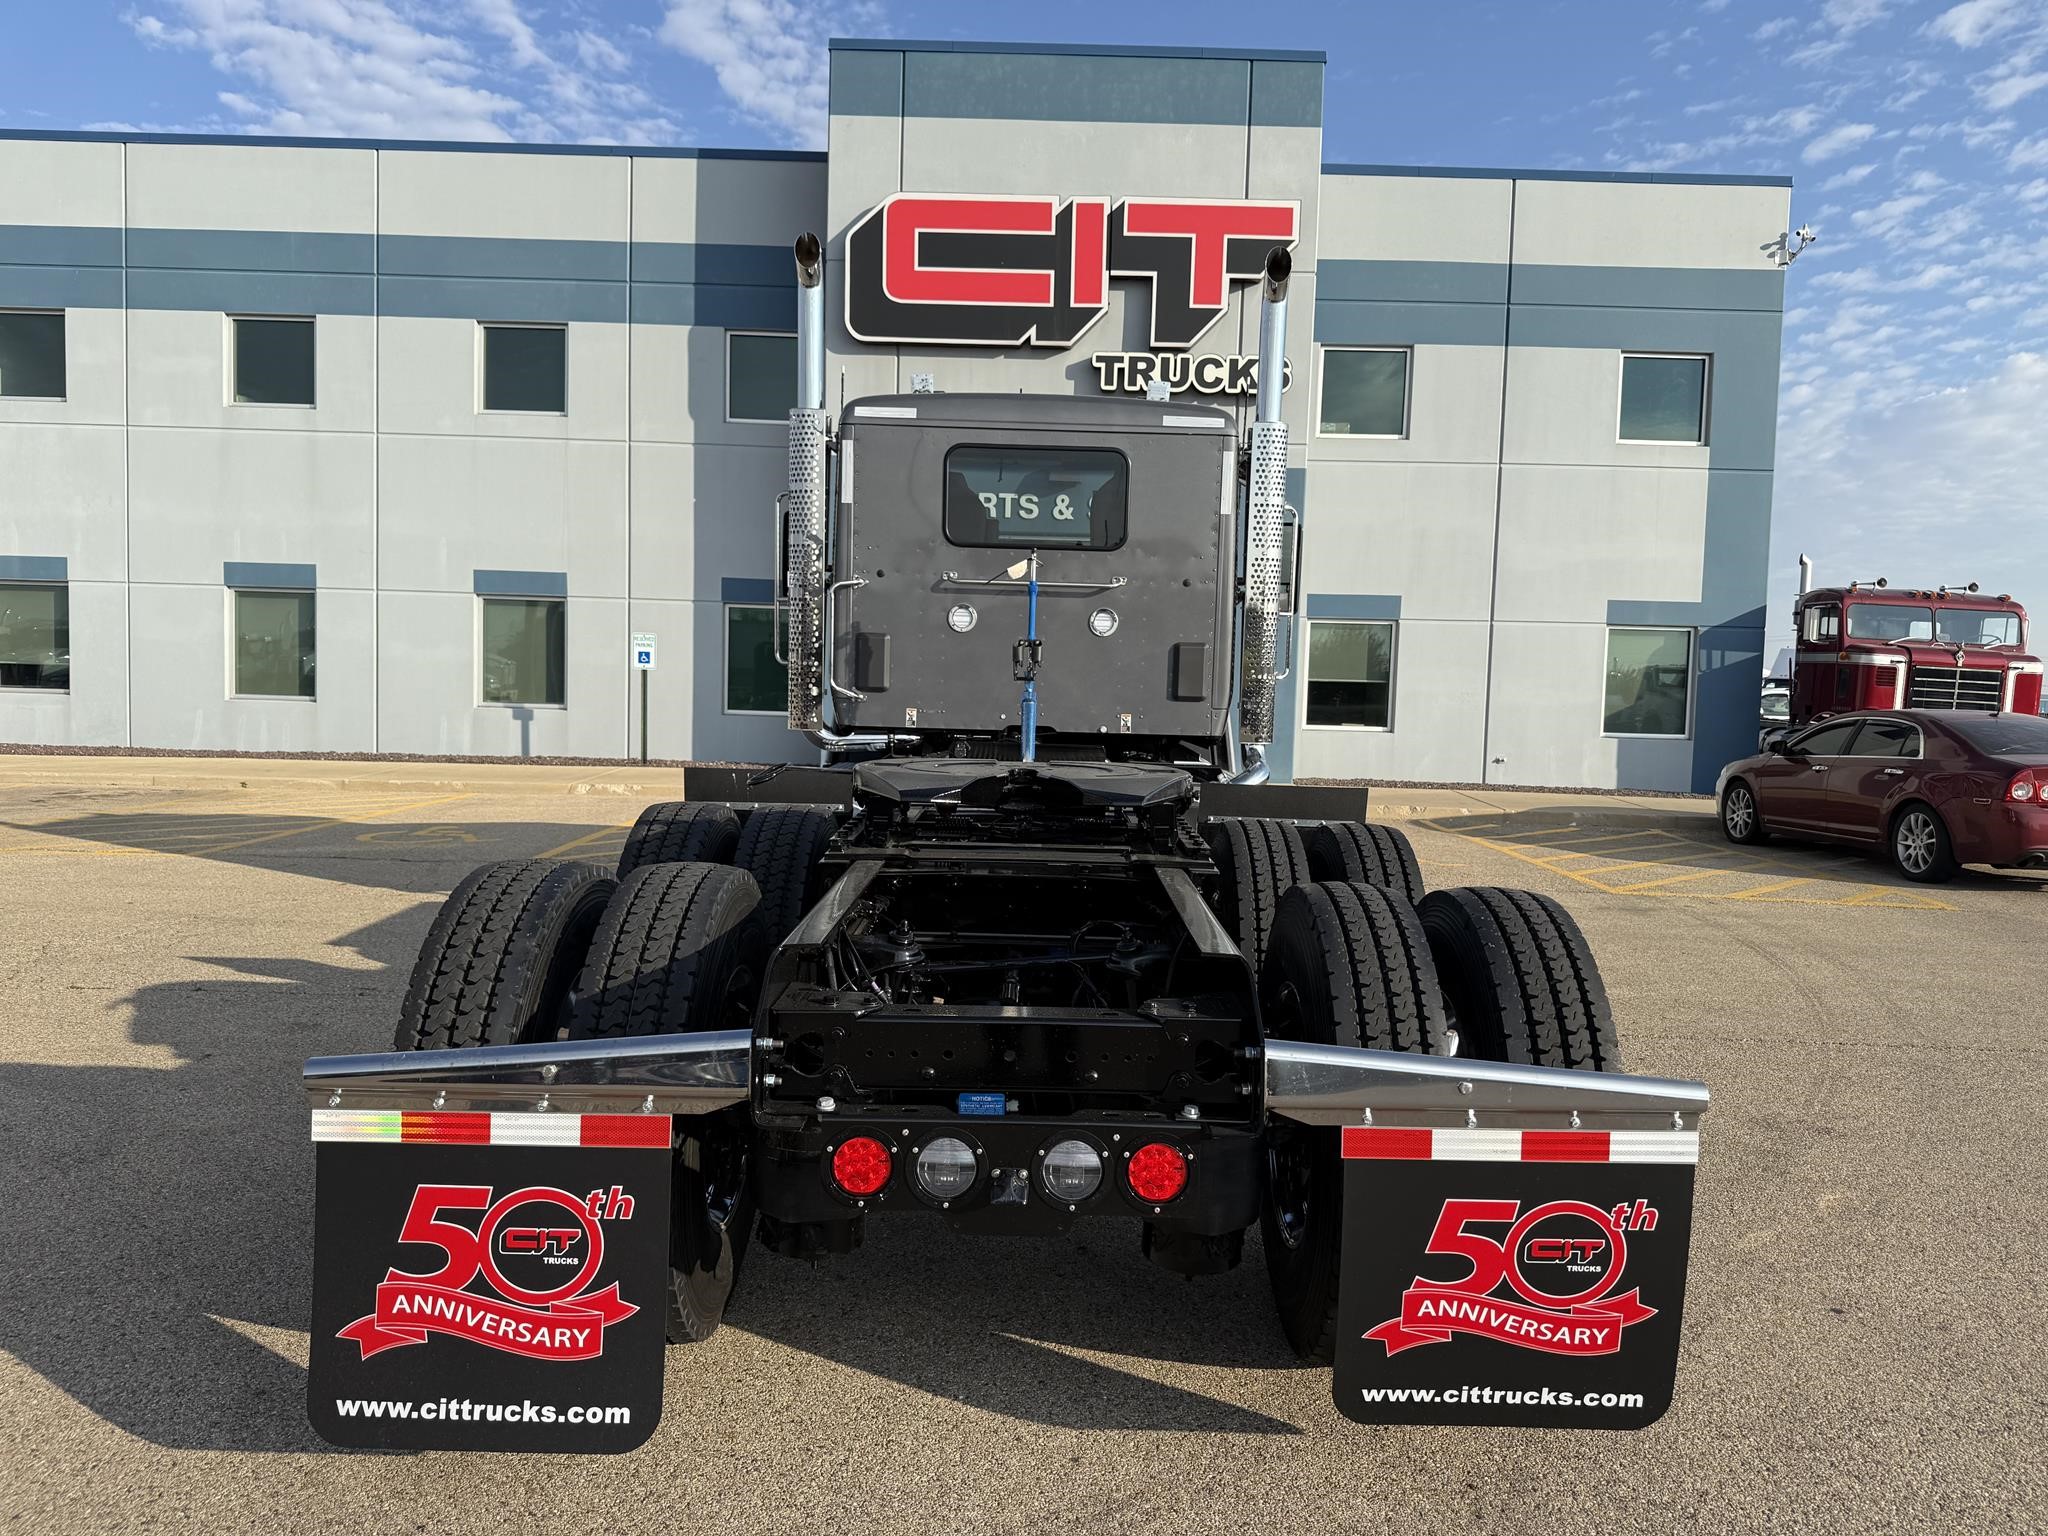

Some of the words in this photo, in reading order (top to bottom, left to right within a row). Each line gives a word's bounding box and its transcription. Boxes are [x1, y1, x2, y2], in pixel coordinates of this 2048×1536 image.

[845, 192, 1301, 349] CIT
[1053, 494, 1074, 520] &
[384, 1184, 636, 1306] 50th
[499, 1227, 582, 1255] CIT
[1411, 1199, 1659, 1309] 50th
[1524, 1239, 1606, 1264] CIT
[542, 1257, 579, 1265] TRUCKS
[1566, 1265, 1602, 1273] TRUCKS
[391, 1294, 592, 1349] ANNIVERSARY
[1416, 1299, 1610, 1345] ANNIVERSARY
[1361, 1385, 1644, 1409] www.cittrucks.com
[335, 1398, 631, 1425] www.cittrucks.com
